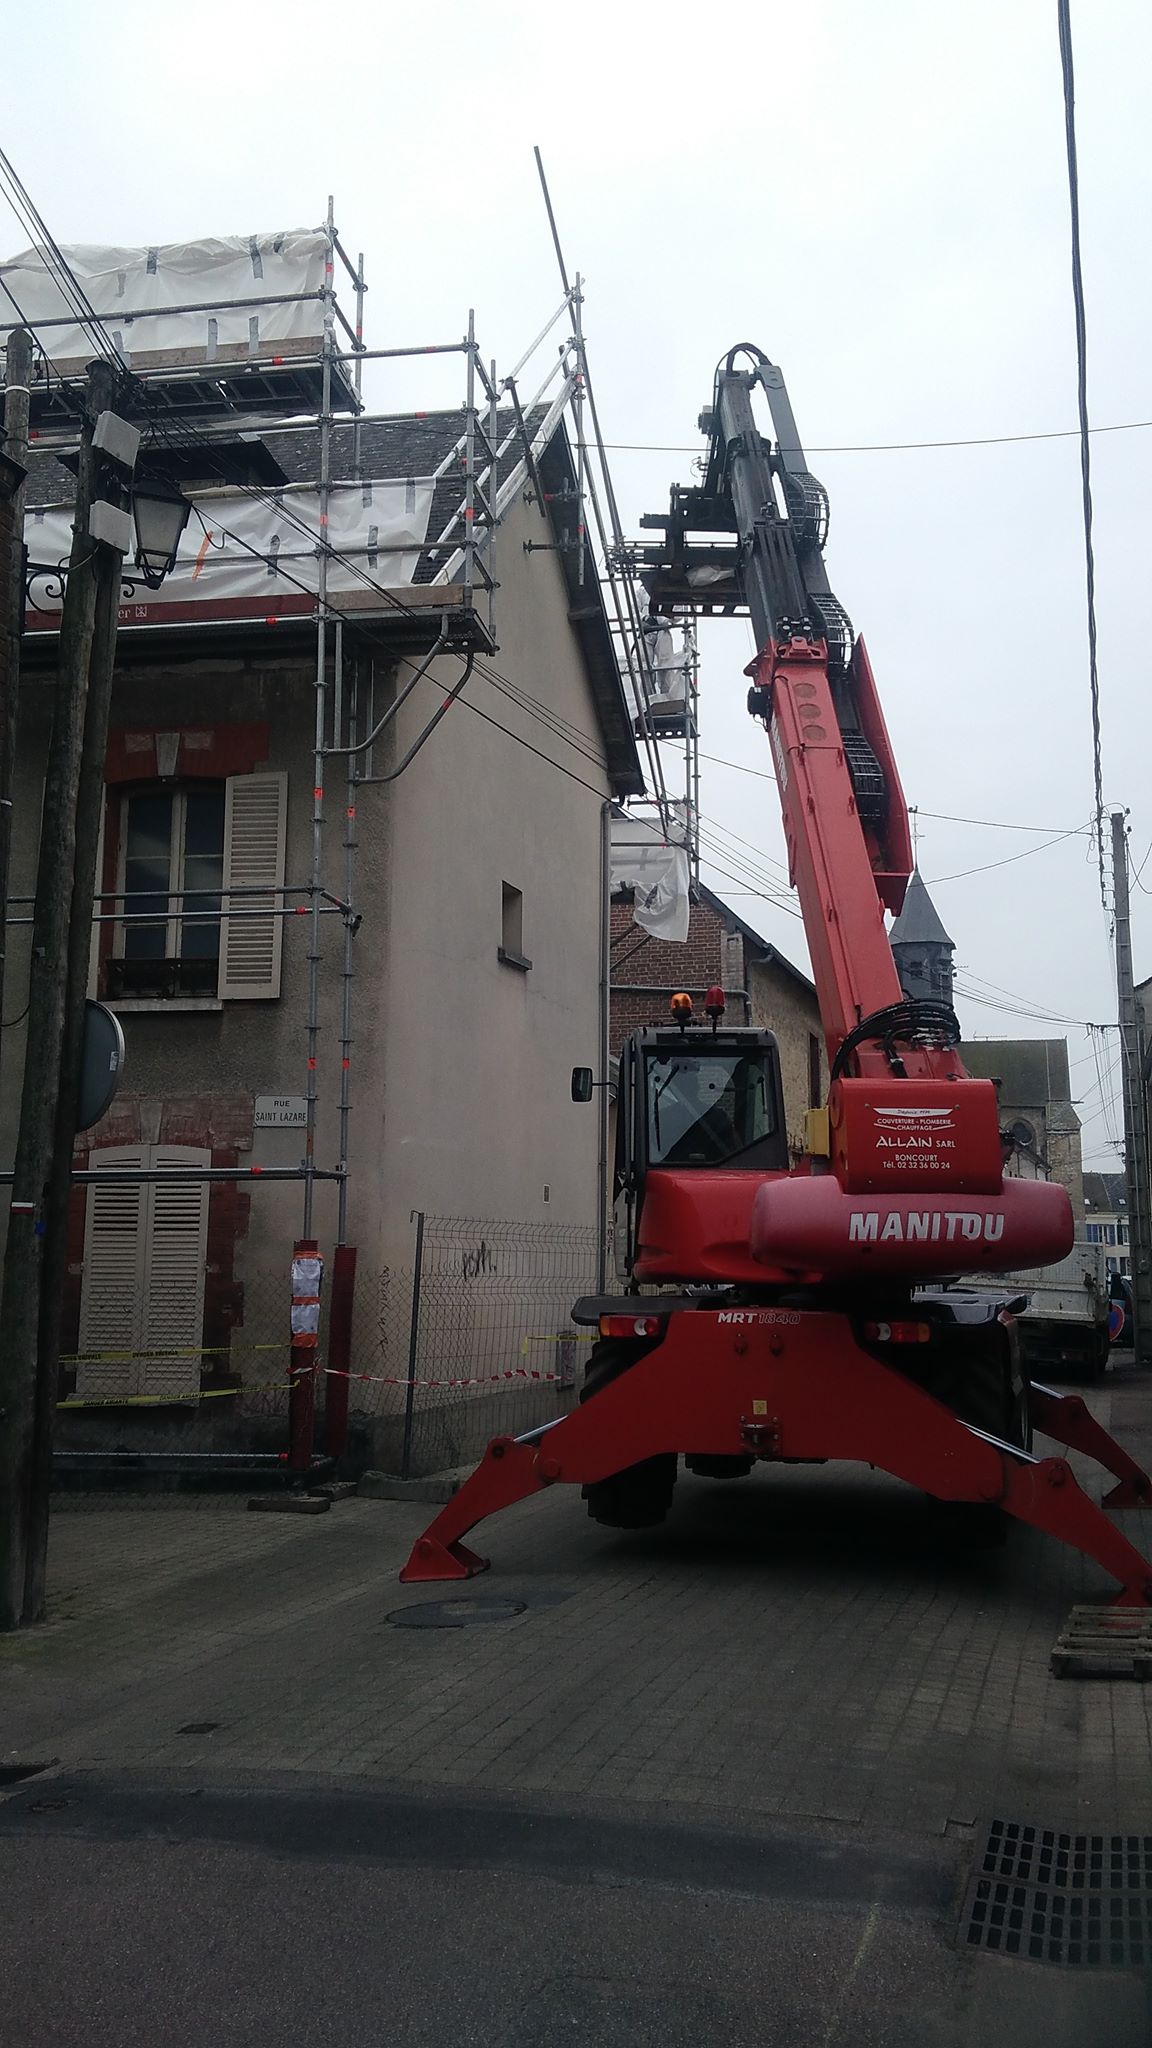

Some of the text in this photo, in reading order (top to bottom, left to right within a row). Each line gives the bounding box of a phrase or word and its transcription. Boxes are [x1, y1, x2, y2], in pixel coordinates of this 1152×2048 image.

[255, 1112, 306, 1121] SAINT LAZARE
[876, 1136, 956, 1148] ALLAIN SARL
[882, 1161, 896, 1169] Tél.
[849, 1212, 1005, 1241] MANITOU
[717, 1312, 801, 1325] MRT 1840
